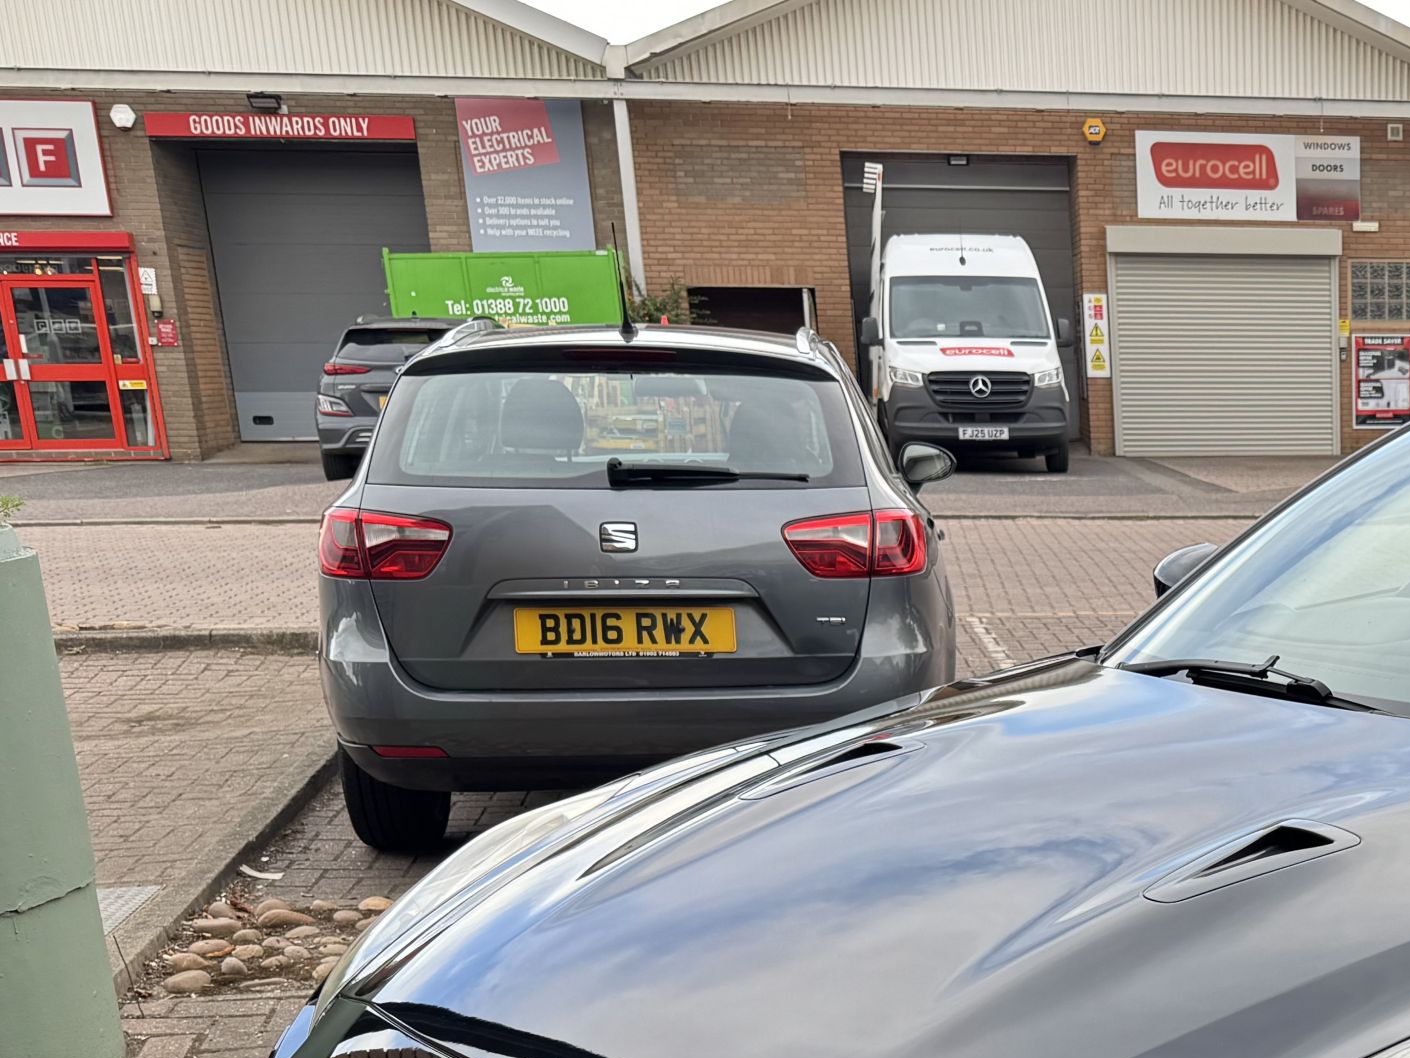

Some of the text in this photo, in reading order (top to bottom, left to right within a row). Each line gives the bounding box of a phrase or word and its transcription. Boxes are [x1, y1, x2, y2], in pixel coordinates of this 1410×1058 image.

[189, 115, 369, 137] GOODS INWARDS ONLY
[462, 115, 502, 137] YOUR
[467, 127, 552, 155] ELECTRICAL
[1303, 142, 1352, 151] WINDOWS
[36, 144, 56, 171] F
[473, 148, 535, 173] EXPERTS
[1161, 154, 1267, 180] eurocell
[1311, 164, 1344, 173] DOORS
[1158, 195, 1284, 213] All together better
[1312, 207, 1345, 216] SPARES
[445, 297, 569, 315] Tel: 01388 72 1000
[945, 348, 1008, 356] eurocell
[962, 429, 986, 438] FJ25
[538, 612, 710, 646] BD16 RWX
